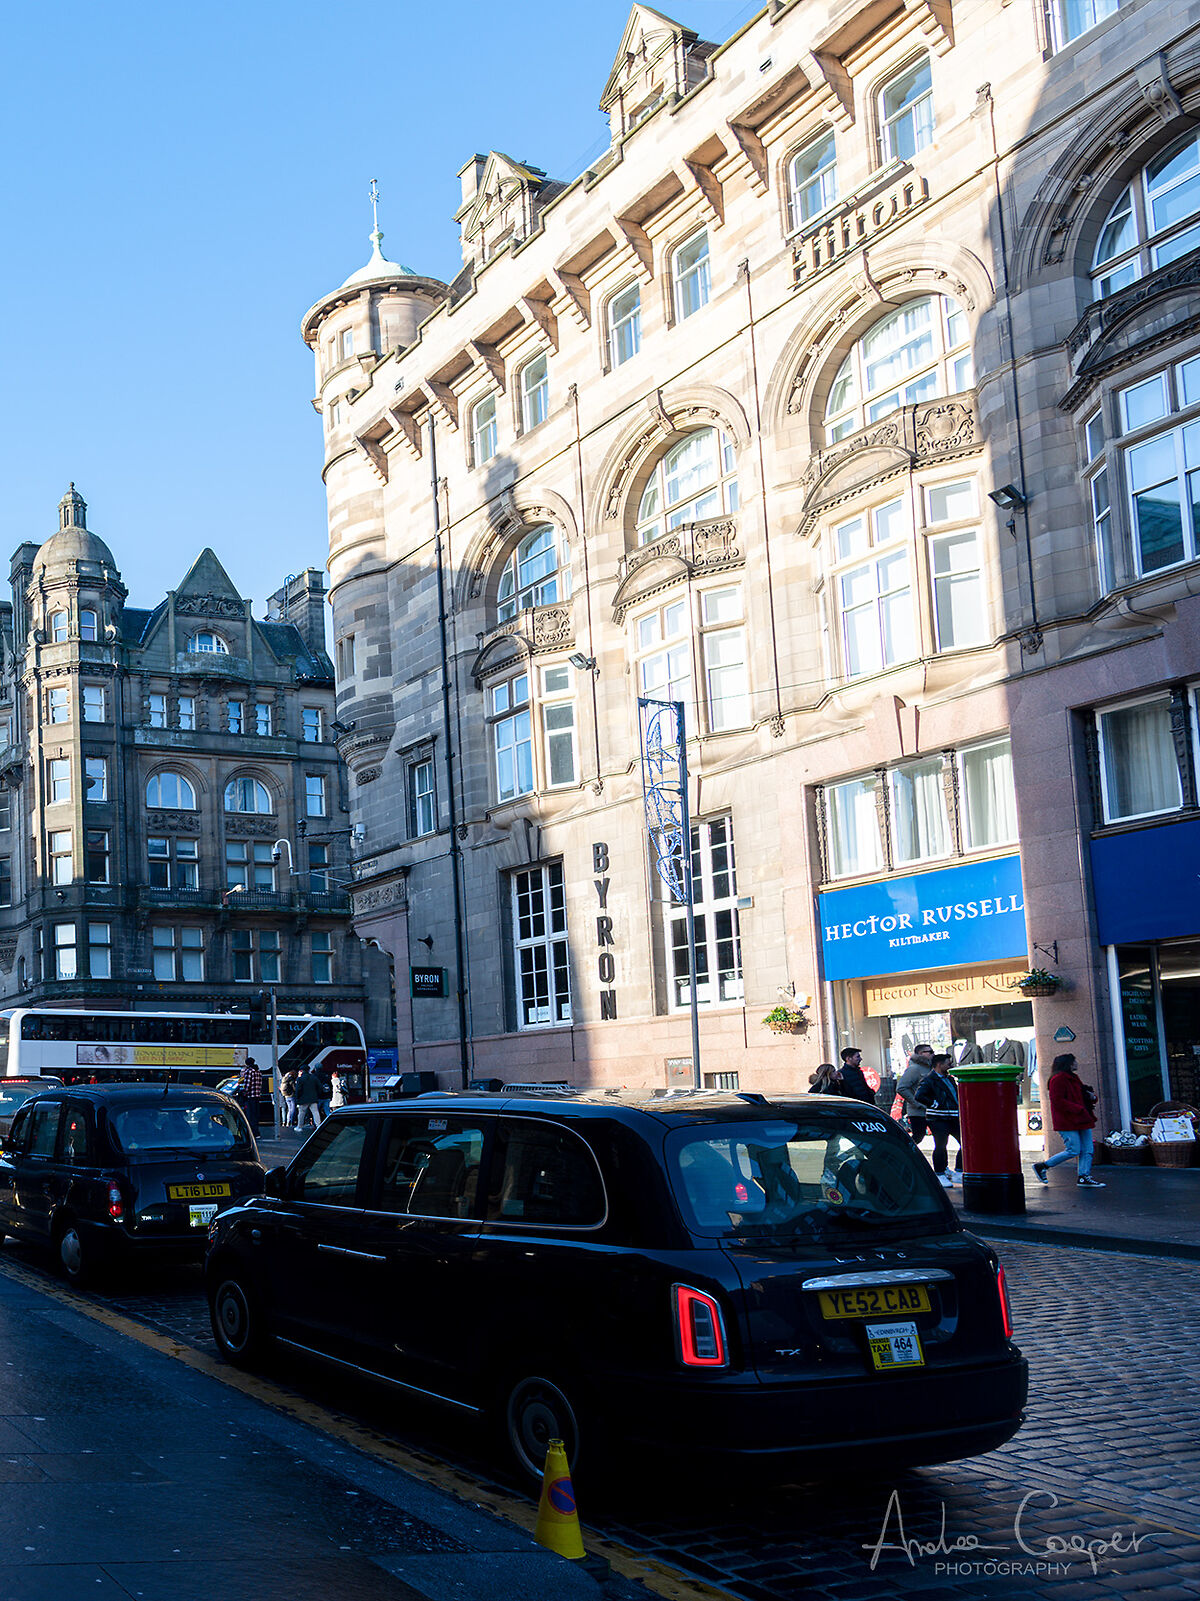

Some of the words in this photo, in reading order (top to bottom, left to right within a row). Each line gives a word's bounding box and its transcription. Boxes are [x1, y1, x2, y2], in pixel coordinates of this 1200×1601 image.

[788, 176, 929, 290] Hilton
[825, 913, 914, 942] HECTOR
[921, 894, 1025, 926] RUSSELL
[592, 841, 618, 1021] BYRON
[414, 974, 440, 983] BYRON
[872, 986, 919, 1002] Hector
[925, 976, 975, 999] Russell
[851, 1121, 887, 1133] V240
[176, 1186, 200, 1197] LT16
[203, 1185, 223, 1195] LDD
[828, 1291, 882, 1314] YE52
[883, 1288, 921, 1310] CAB
[872, 1344, 891, 1352] TAXI
[894, 1337, 913, 1350] 464
[775, 1348, 801, 1356] TX
